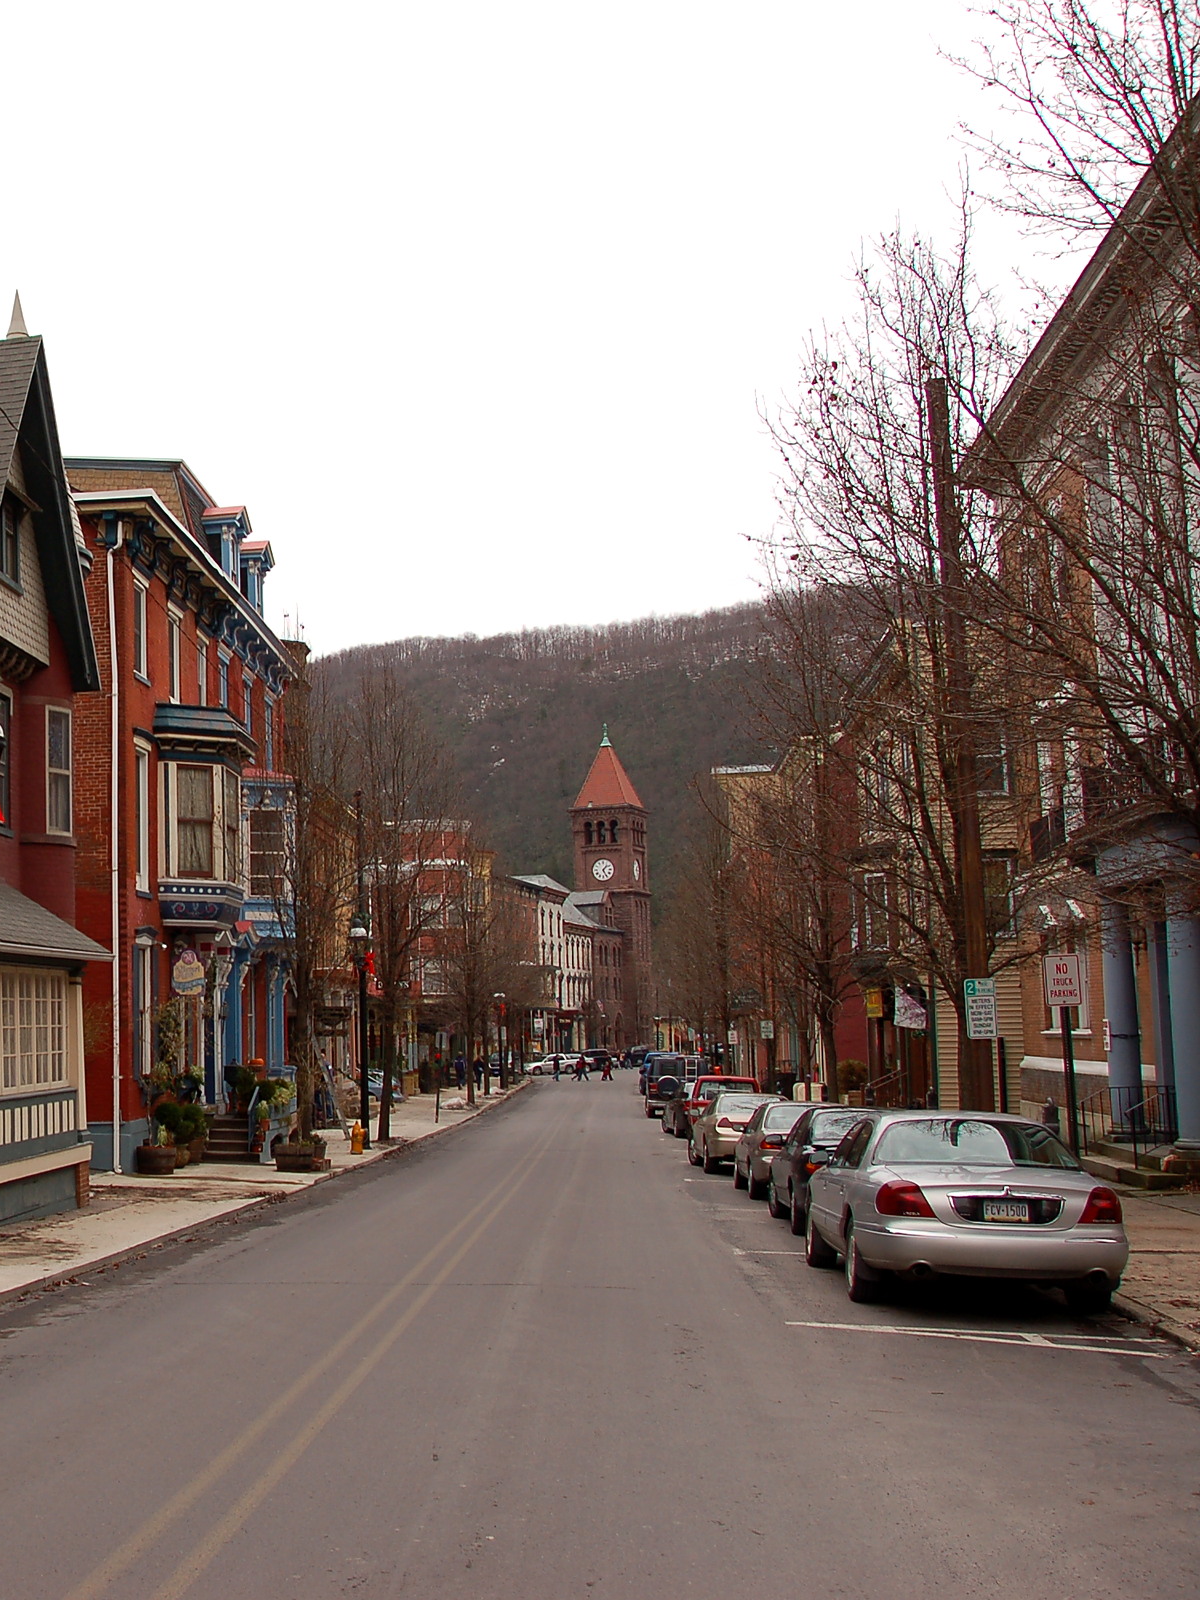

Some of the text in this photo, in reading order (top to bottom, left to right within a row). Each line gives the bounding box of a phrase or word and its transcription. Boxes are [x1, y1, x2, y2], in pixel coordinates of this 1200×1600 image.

[1055, 963, 1068, 975] NO
[1052, 977, 1073, 986] TRUCK
[966, 982, 975, 994] 2
[1050, 989, 1078, 998] PARKING
